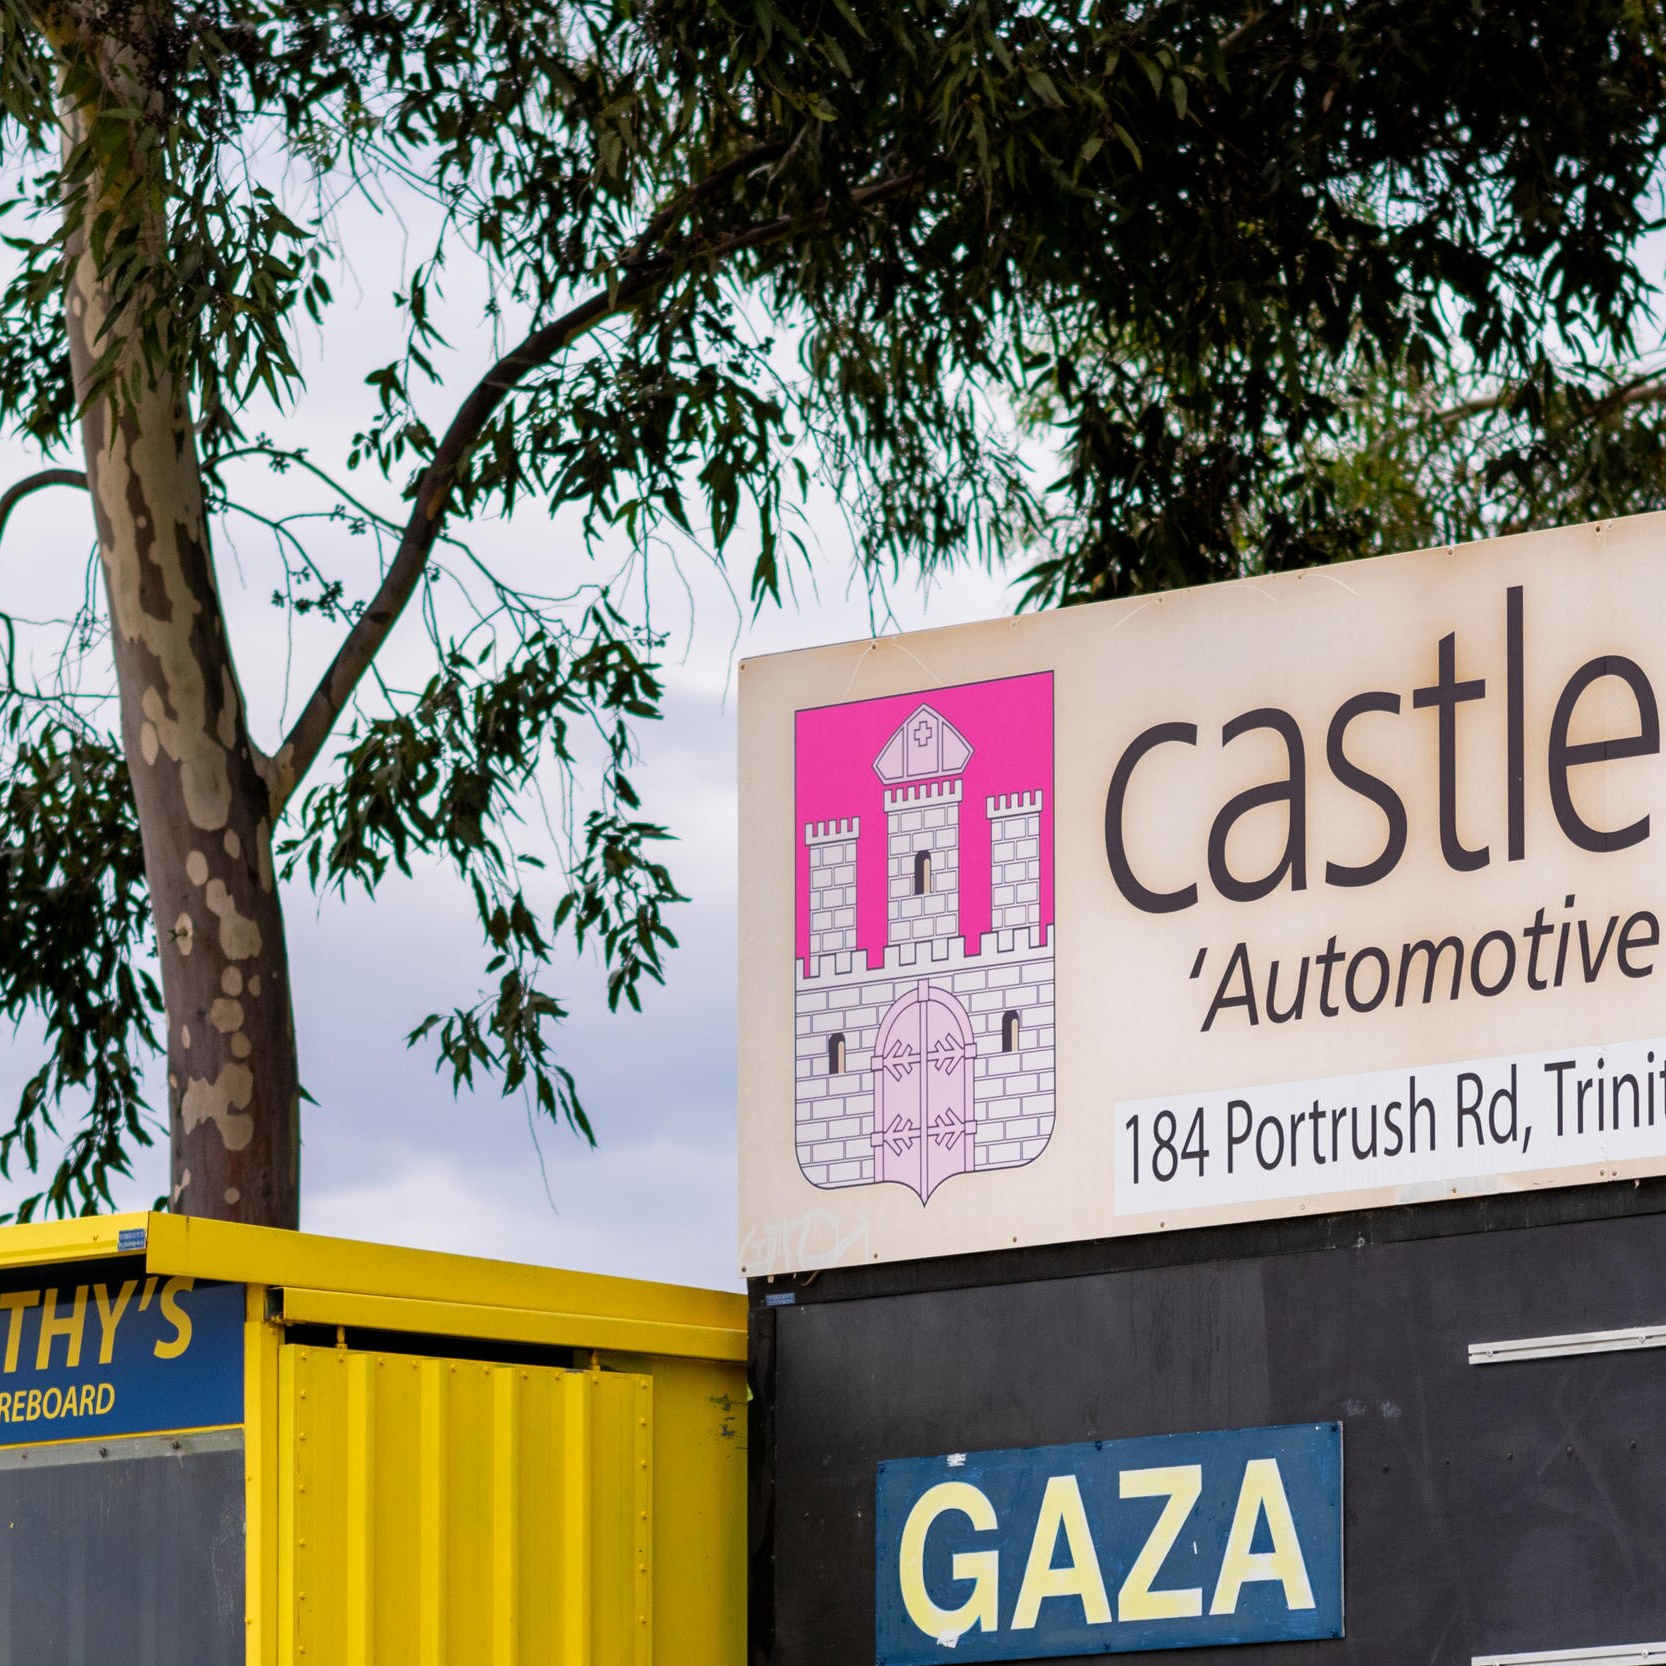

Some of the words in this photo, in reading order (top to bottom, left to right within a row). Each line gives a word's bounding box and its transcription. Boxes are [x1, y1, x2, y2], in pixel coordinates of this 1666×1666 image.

[1104, 584, 1661, 914] castle
[1125, 1099, 1210, 1184] 184
[1227, 1072, 1436, 1174] Portrush
[1457, 1063, 1533, 1154] Rd,
[899, 1458, 1317, 1641] GAZA
